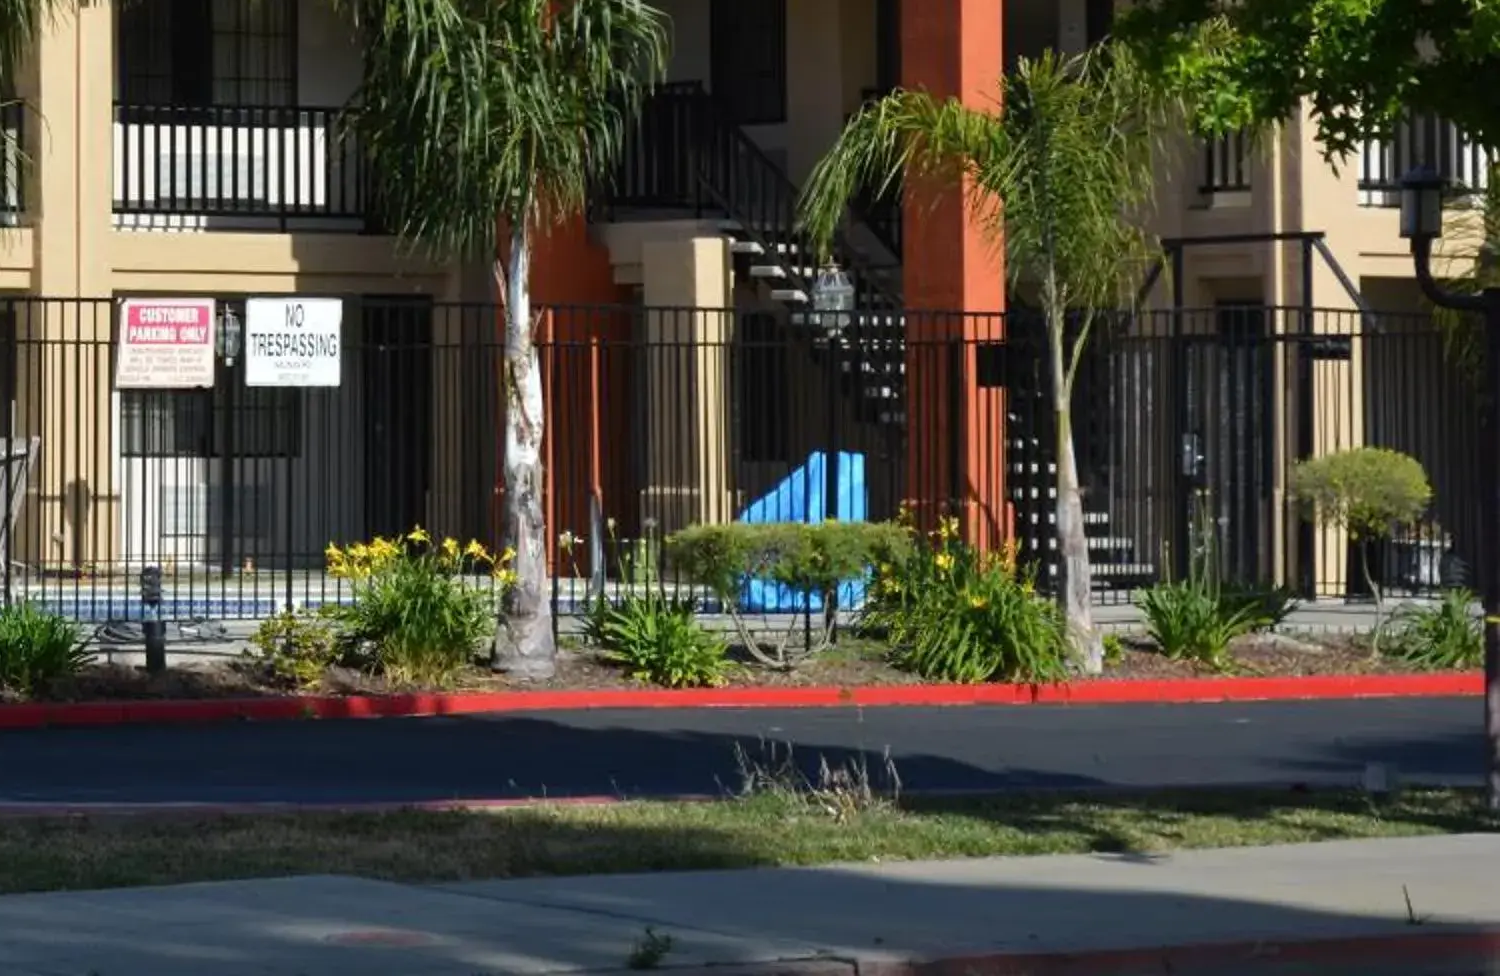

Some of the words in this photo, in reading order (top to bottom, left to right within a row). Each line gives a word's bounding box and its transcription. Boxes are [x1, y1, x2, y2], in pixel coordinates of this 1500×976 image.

[139, 307, 199, 324] CUSTOMER
[285, 303, 305, 328] NO
[129, 325, 177, 342] PARKING
[179, 325, 208, 342] ONLY
[251, 332, 338, 358] TRESPASSING
